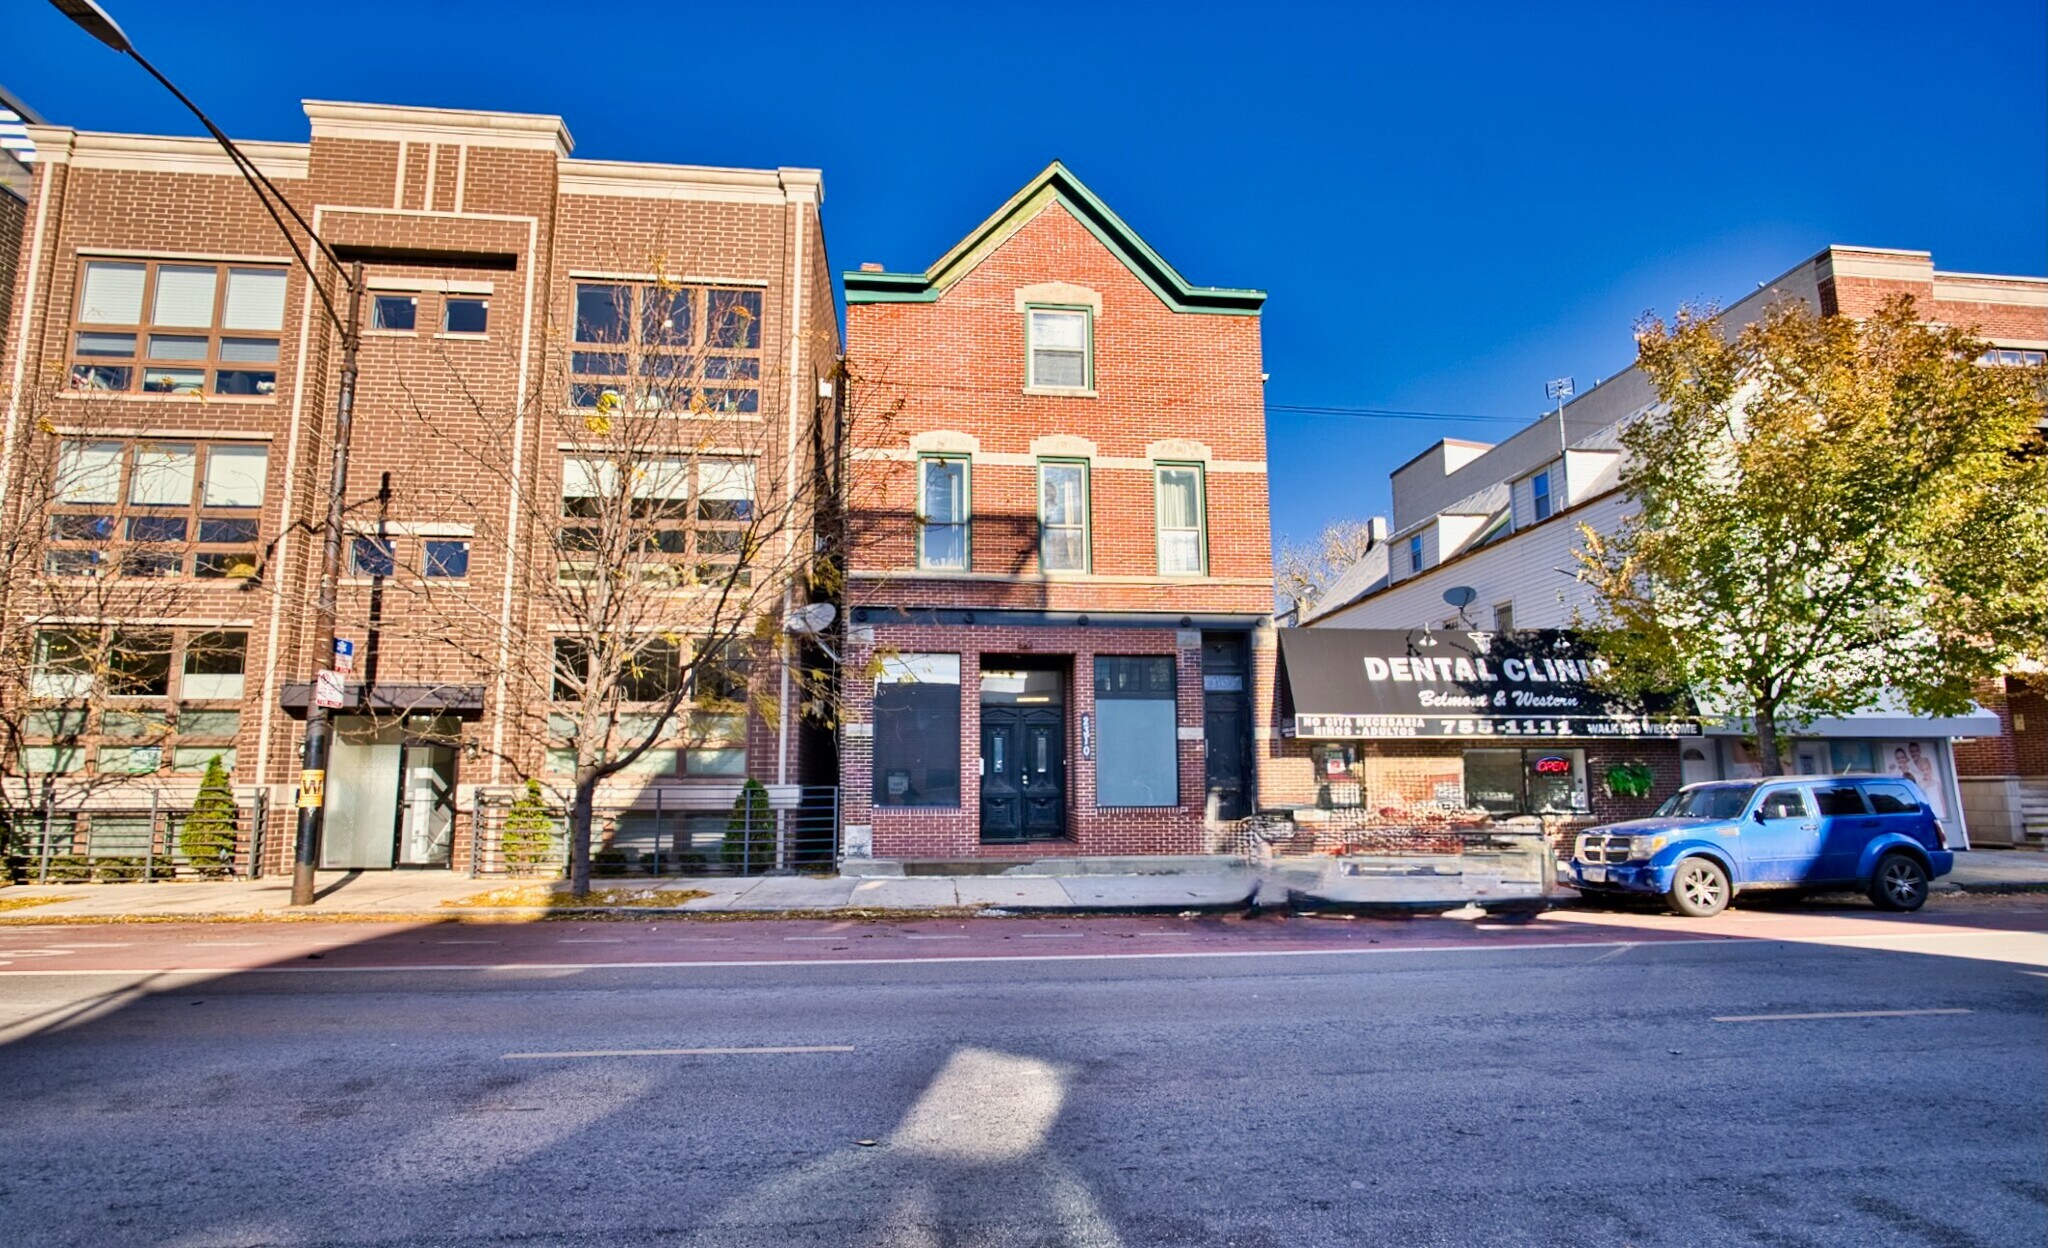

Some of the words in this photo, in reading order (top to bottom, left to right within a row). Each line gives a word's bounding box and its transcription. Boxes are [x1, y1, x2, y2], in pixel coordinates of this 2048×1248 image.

[1364, 657, 1498, 681] DENTAL
[1418, 690, 1488, 707] Belmont
[1493, 690, 1507, 706] &
[1511, 690, 1579, 707] Western
[1303, 717, 1321, 727] NO
[1324, 717, 1353, 727] CITA
[1356, 717, 1425, 728] NECESARIA
[1440, 719, 1573, 735] 755-1111
[1586, 723, 1619, 734] WALK
[1643, 722, 1697, 735] WELCOME
[1537, 760, 1570, 773] OPEN
